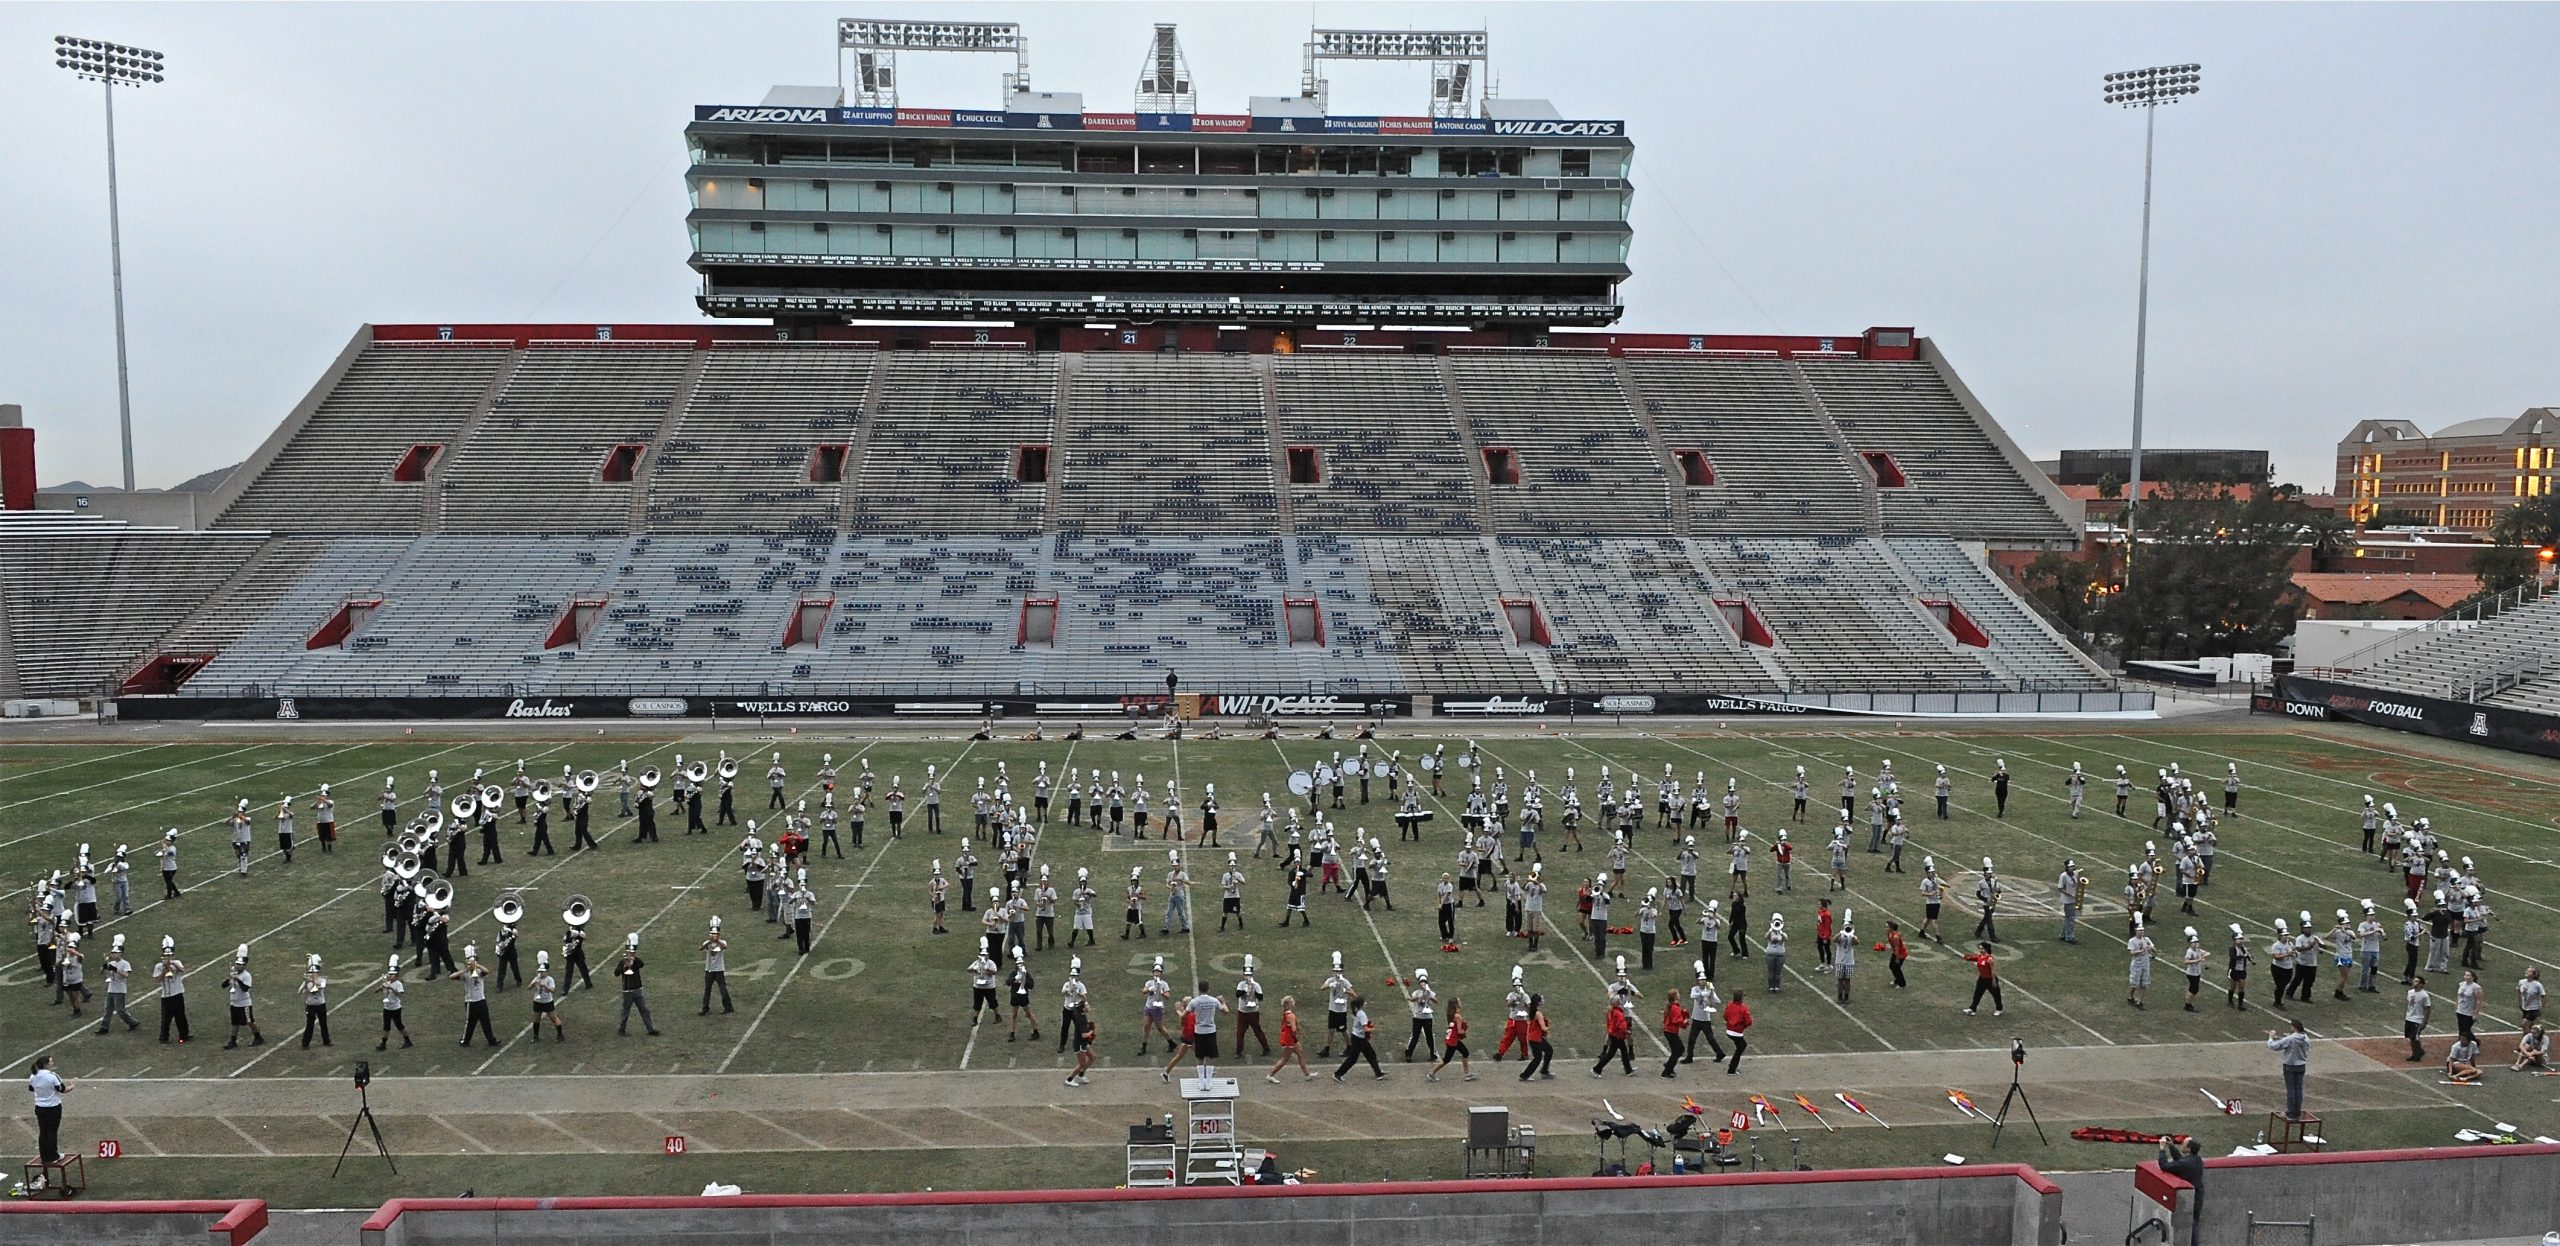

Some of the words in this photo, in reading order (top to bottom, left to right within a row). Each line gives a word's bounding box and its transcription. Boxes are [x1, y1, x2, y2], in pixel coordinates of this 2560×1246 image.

[708, 109, 827, 122] ARIZONA
[843, 111, 850, 119] 22
[1494, 121, 1617, 135] WILDCATS
[440, 331, 451, 340] 17
[598, 331, 610, 340] 18
[777, 332, 788, 342] 19
[976, 332, 988, 342] 20
[1124, 334, 1135, 344] 21
[1344, 336, 1356, 346] 22
[1536, 339, 1548, 348] 23
[1690, 341, 1702, 350] 24
[1821, 343, 1832, 352] 25
[77, 498, 88, 506] 16
[505, 699, 574, 717] Bashas'
[743, 702, 795, 712] WELLS
[798, 702, 850, 712] FARGO
[1707, 699, 1756, 710] WELLS
[2286, 702, 2324, 718] DOWN
[2368, 701, 2422, 720] FOOTBALL
[2229, 1100, 2242, 1114] 30
[1732, 1112, 1745, 1128] 40
[1203, 1120, 1217, 1134] 50
[99, 1142, 116, 1157] 30
[666, 1138, 682, 1152] 40
